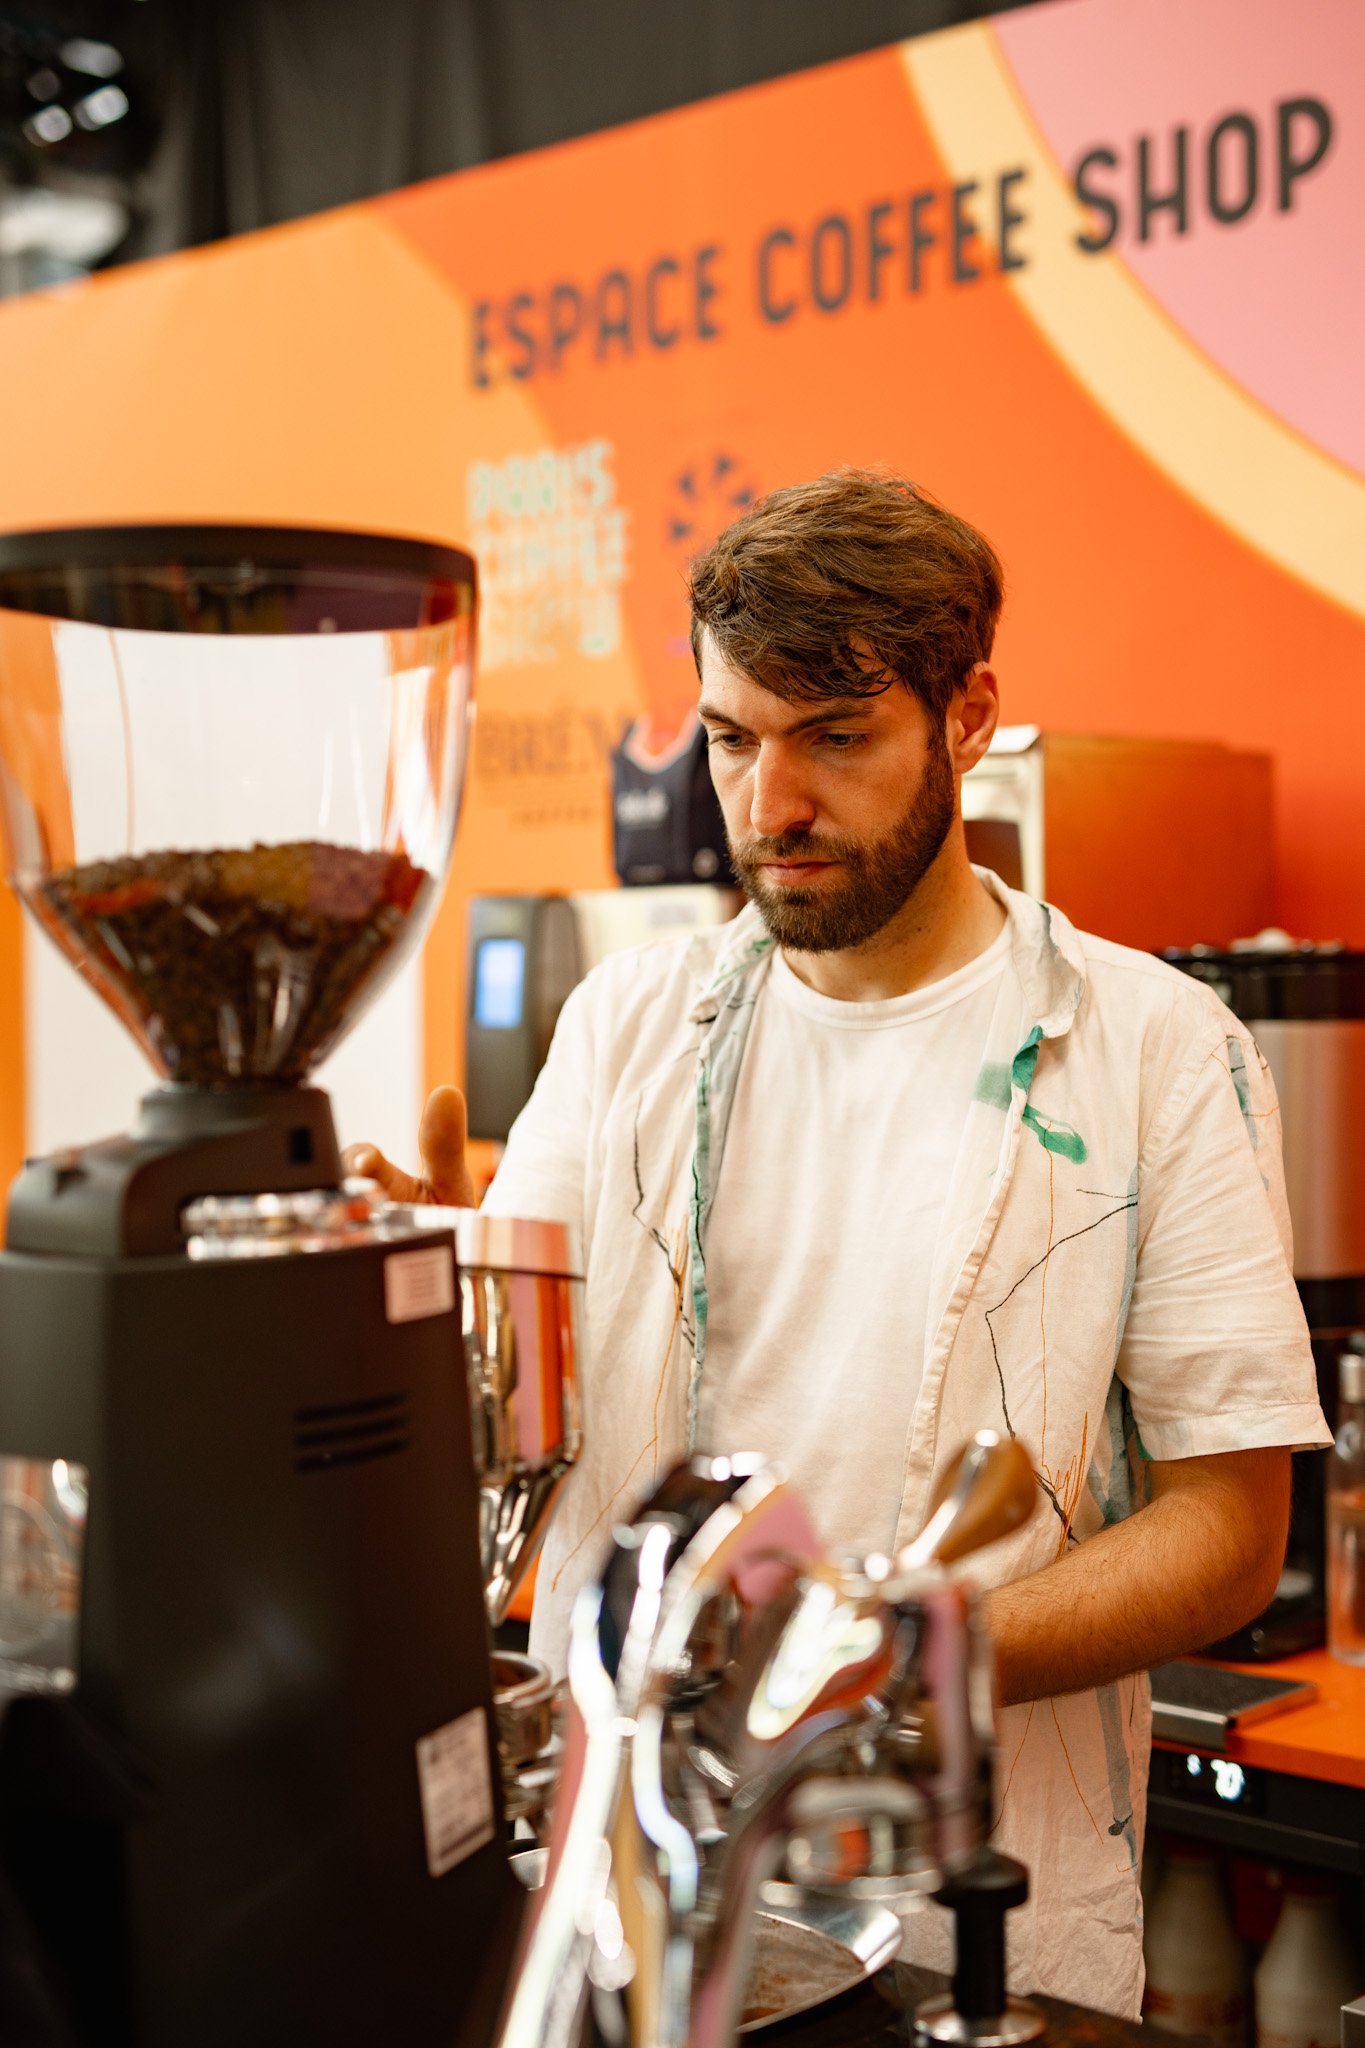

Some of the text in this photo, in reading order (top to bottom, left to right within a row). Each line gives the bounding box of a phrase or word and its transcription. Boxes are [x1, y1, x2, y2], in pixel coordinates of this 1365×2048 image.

[471, 96, 1335, 390] ESPACE COFFEE SHOP
